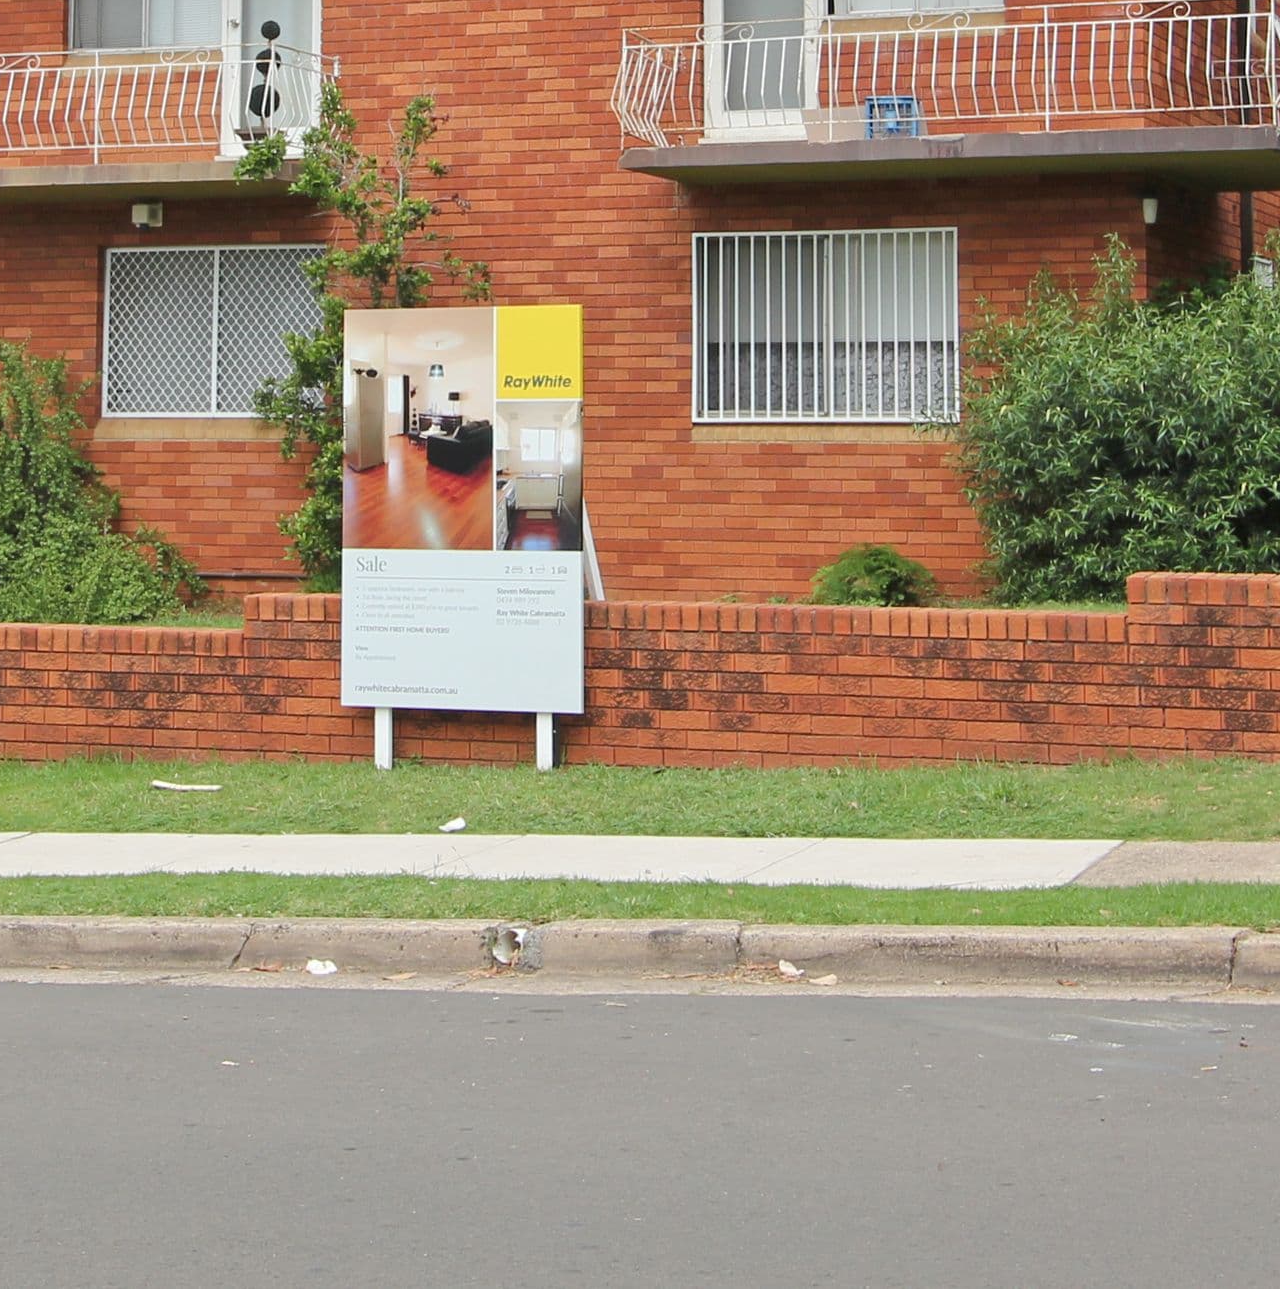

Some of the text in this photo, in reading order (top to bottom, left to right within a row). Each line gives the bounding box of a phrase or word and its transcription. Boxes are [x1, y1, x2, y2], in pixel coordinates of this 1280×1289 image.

[356, 554, 388, 573] Sale
[504, 565, 510, 575] 2
[354, 684, 458, 695] raywhitecabramatta.com.au
